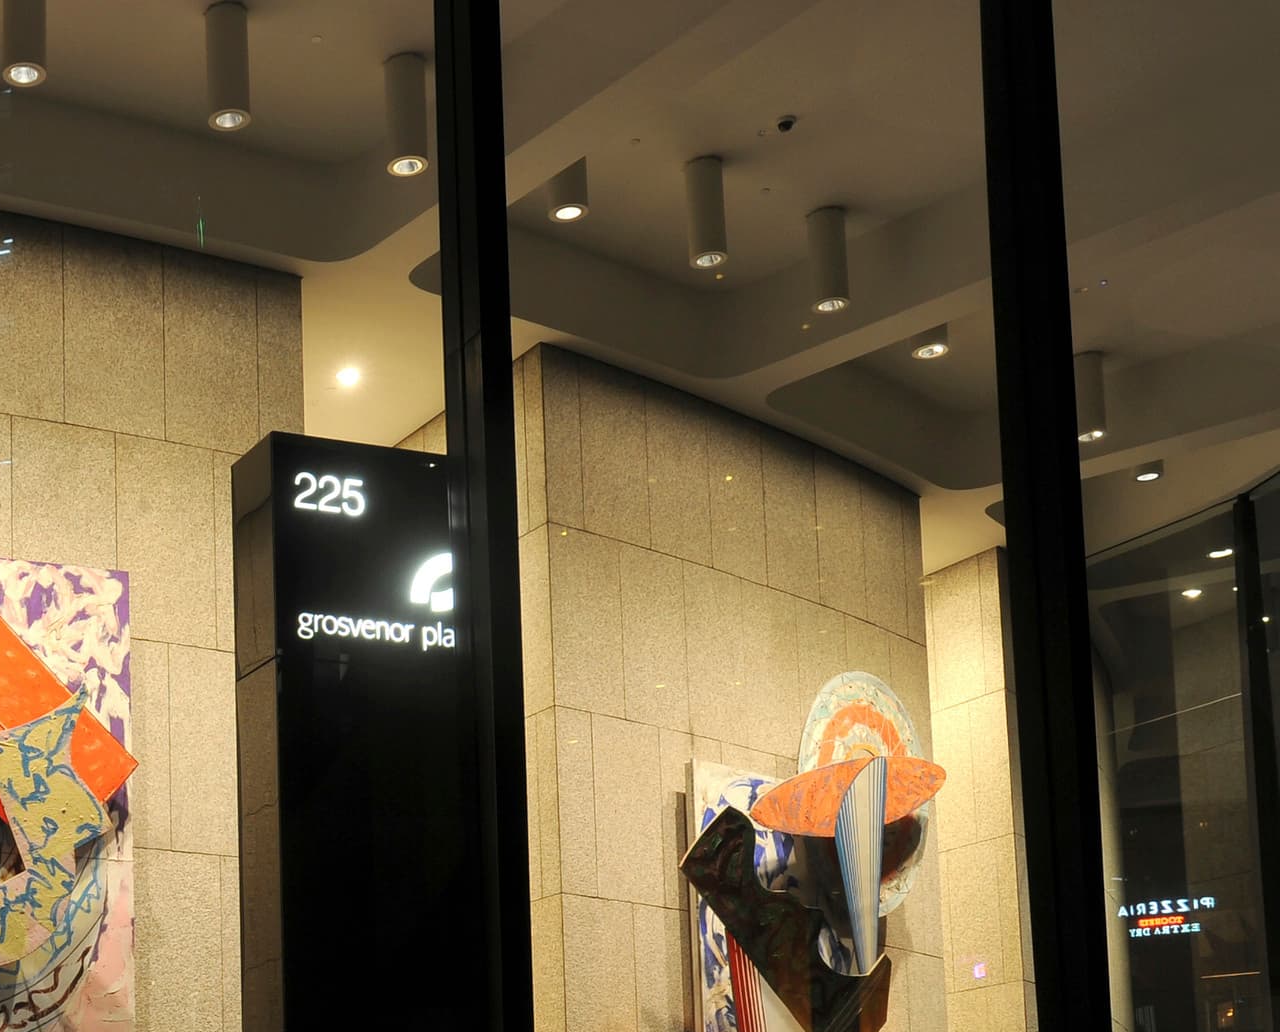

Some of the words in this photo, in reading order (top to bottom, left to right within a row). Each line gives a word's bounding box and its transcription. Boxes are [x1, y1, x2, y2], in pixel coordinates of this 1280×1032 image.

[293, 471, 366, 517] 225
[297, 611, 415, 640] grosvenor
[421, 621, 456, 651] pla
